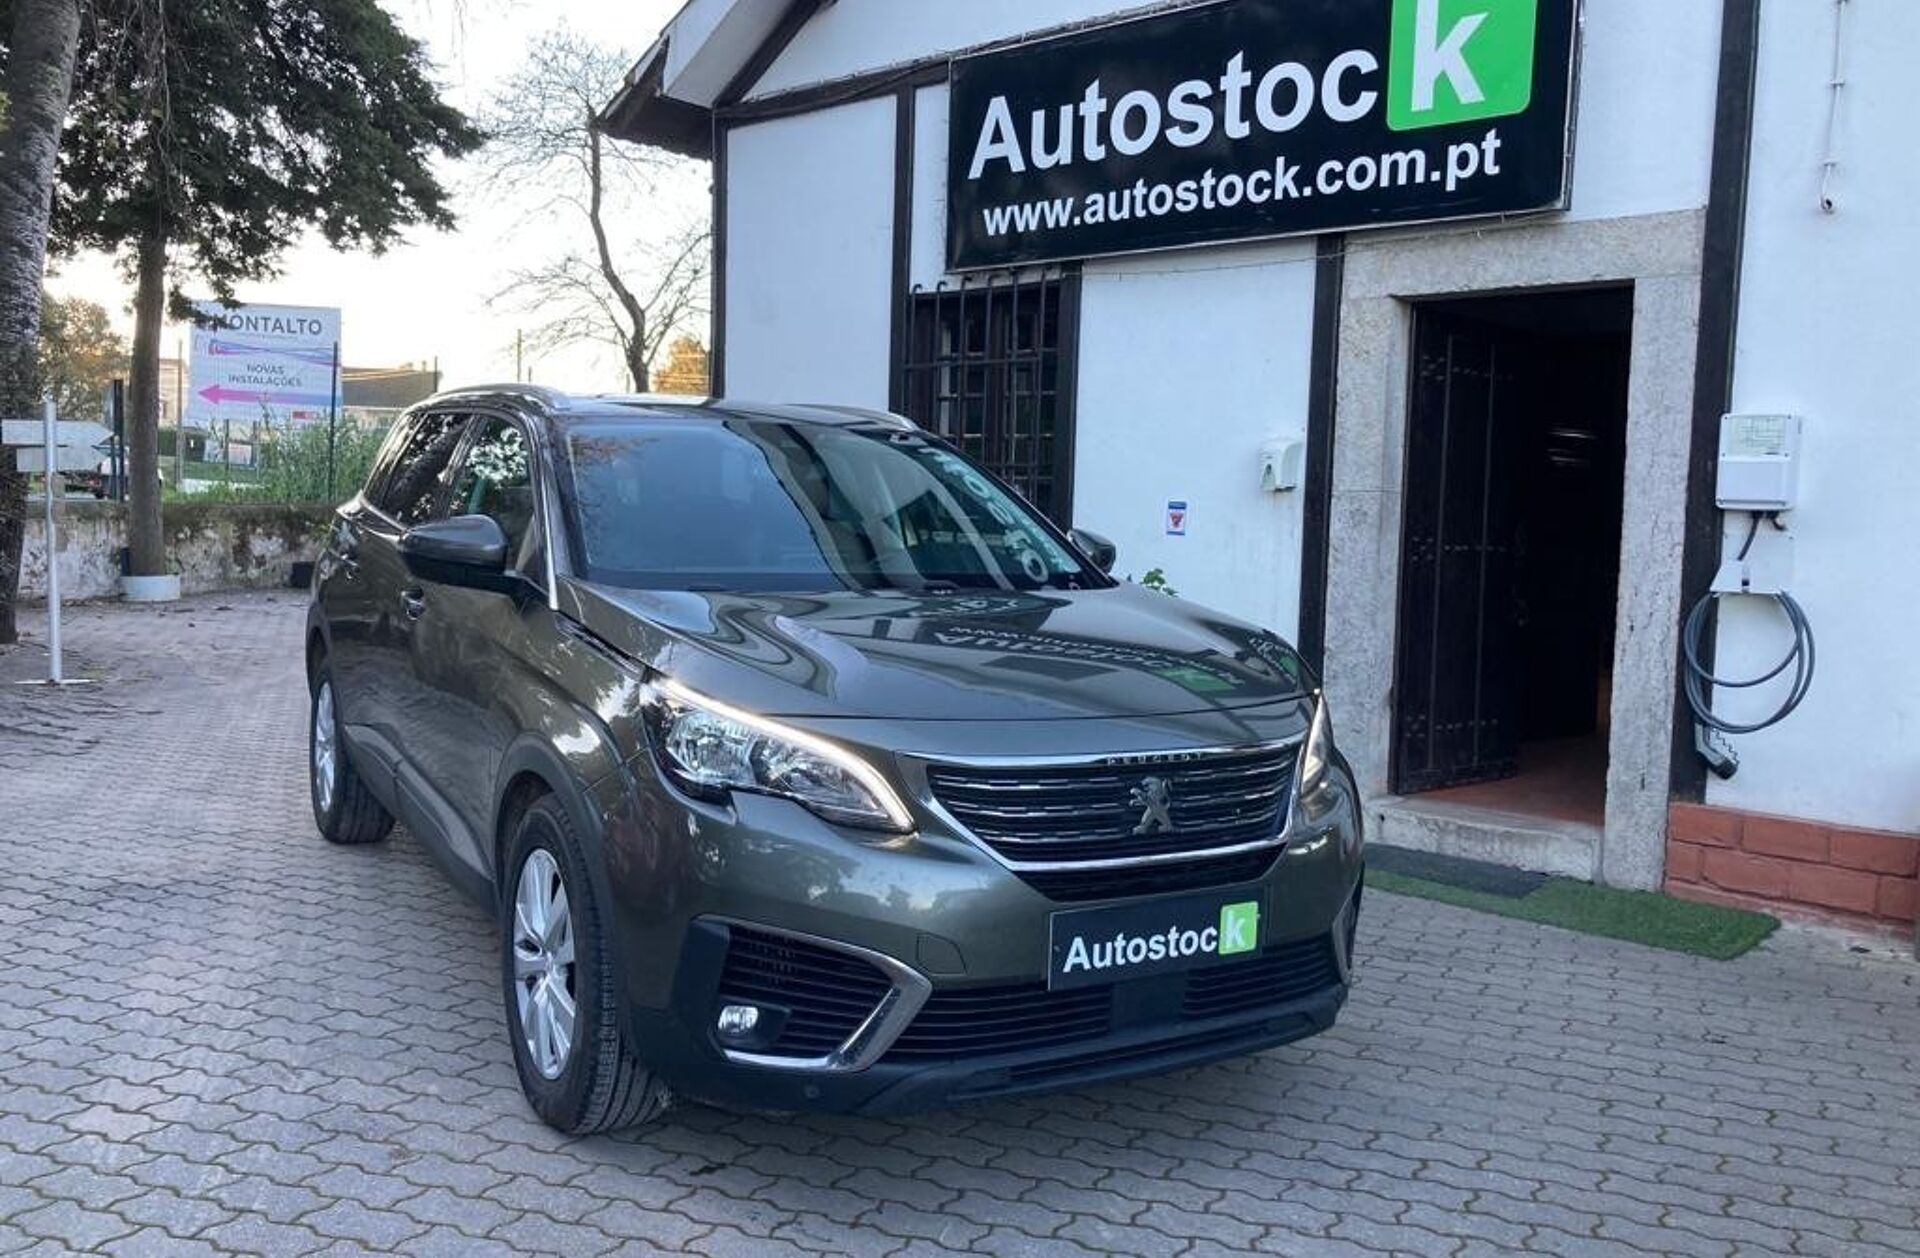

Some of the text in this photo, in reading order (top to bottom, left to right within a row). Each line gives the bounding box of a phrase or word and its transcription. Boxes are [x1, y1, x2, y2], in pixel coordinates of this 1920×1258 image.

[968, 0, 1489, 180] Autostock
[983, 128, 1501, 237] www.autostock.com.pt
[247, 364, 285, 374] NOVAS
[1063, 910, 1246, 973] Autostock
